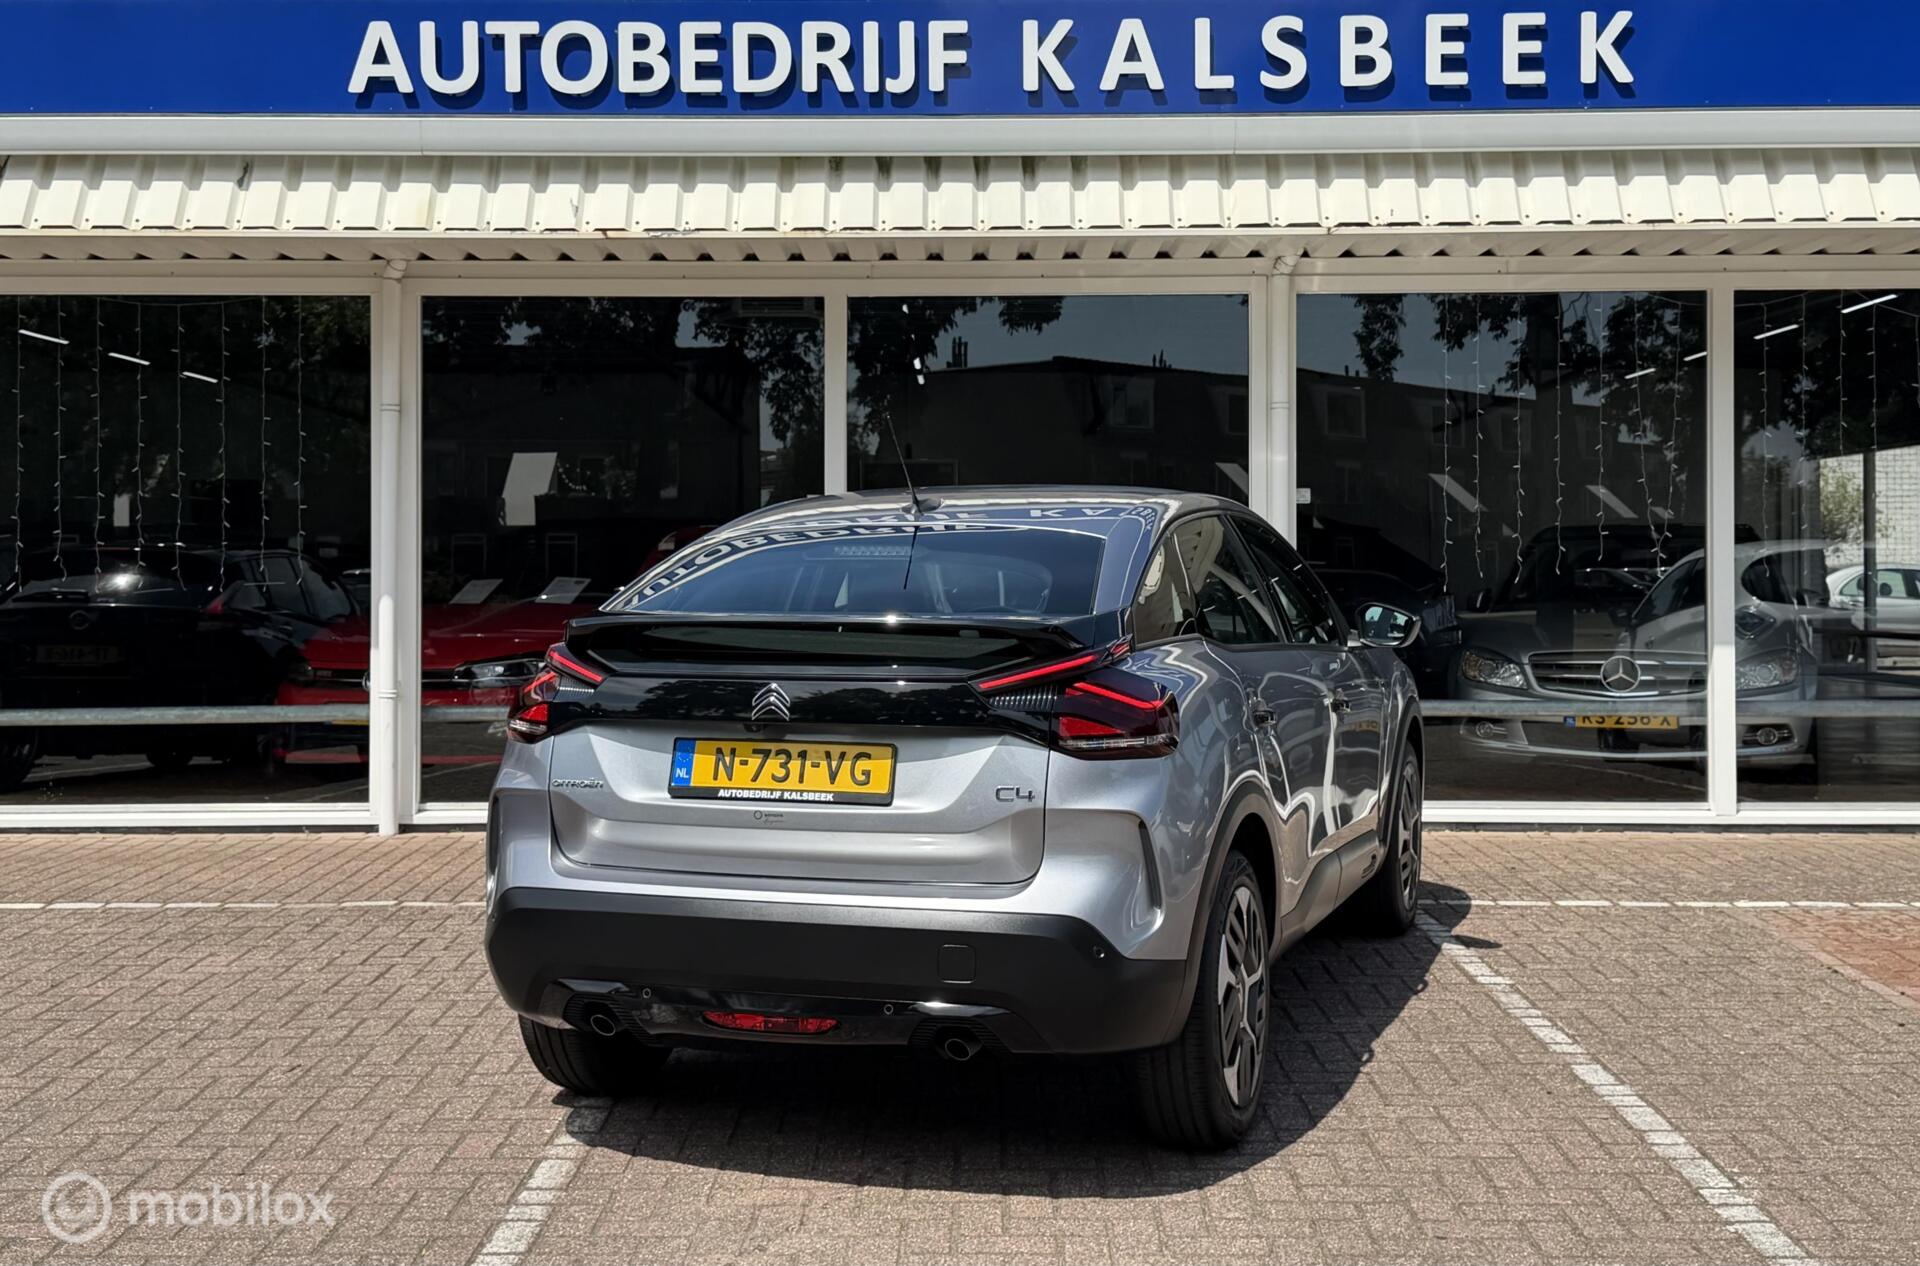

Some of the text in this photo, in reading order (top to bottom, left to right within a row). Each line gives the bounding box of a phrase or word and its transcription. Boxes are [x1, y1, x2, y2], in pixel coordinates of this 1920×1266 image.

[348, 11, 1635, 94] AUTOBEDRIJF KALSBEEK
[675, 768, 689, 779] NL
[712, 746, 872, 787] N-731-VG
[718, 789, 834, 802] AUTOBEDRIJF KALSBEEK
[995, 785, 1036, 803] C4
